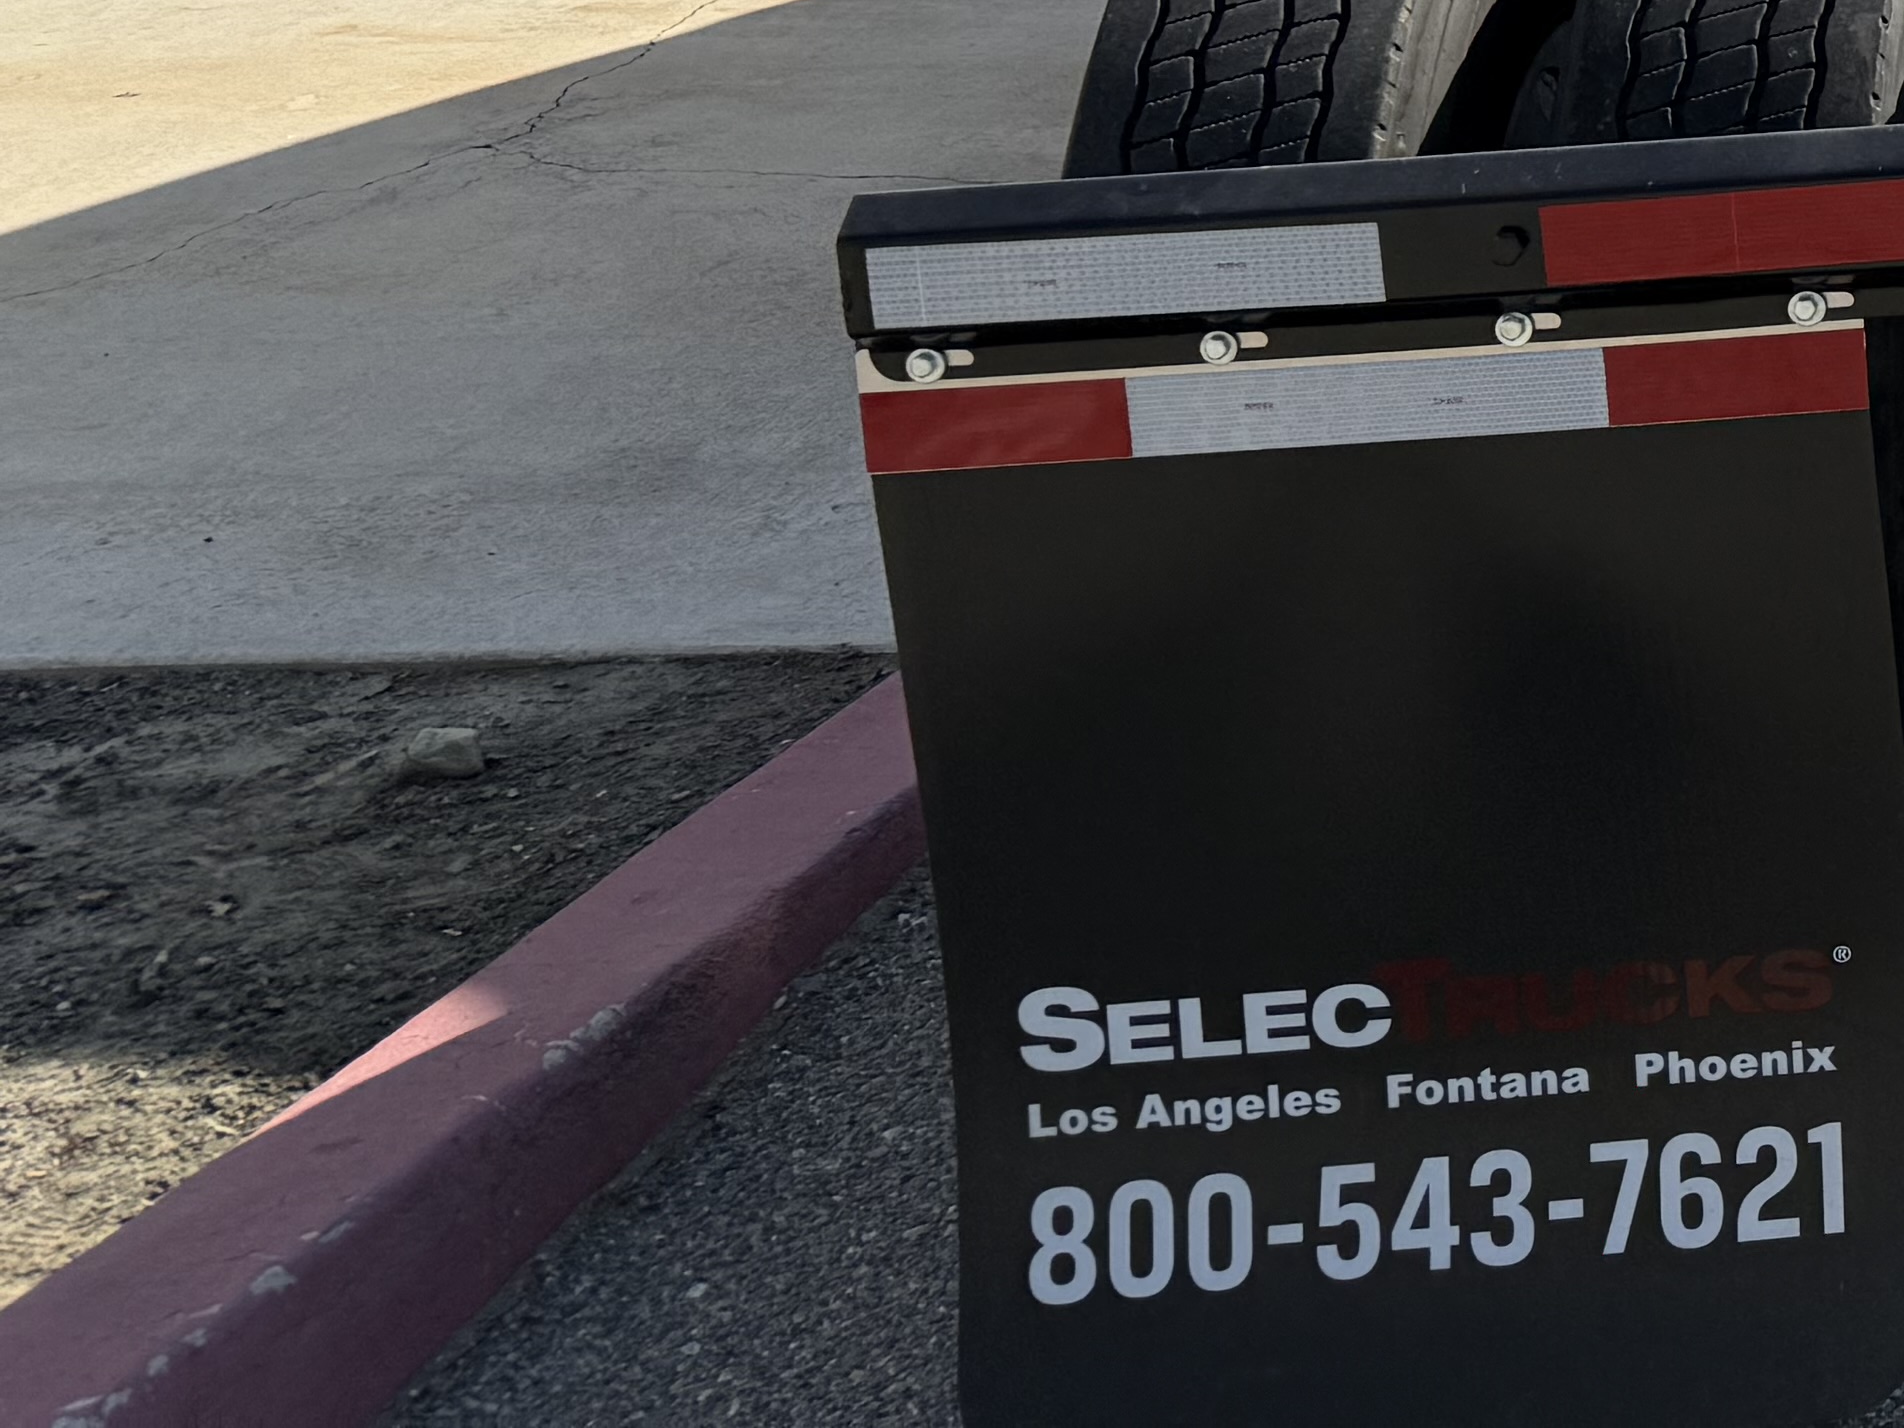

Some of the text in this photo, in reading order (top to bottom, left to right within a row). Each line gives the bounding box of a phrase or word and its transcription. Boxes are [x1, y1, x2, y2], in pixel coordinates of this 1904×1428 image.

[1029, 1041, 1836, 1137] Los Angeles Fontana Phoenix
[1028, 1122, 1846, 1305] 800-543-7621
